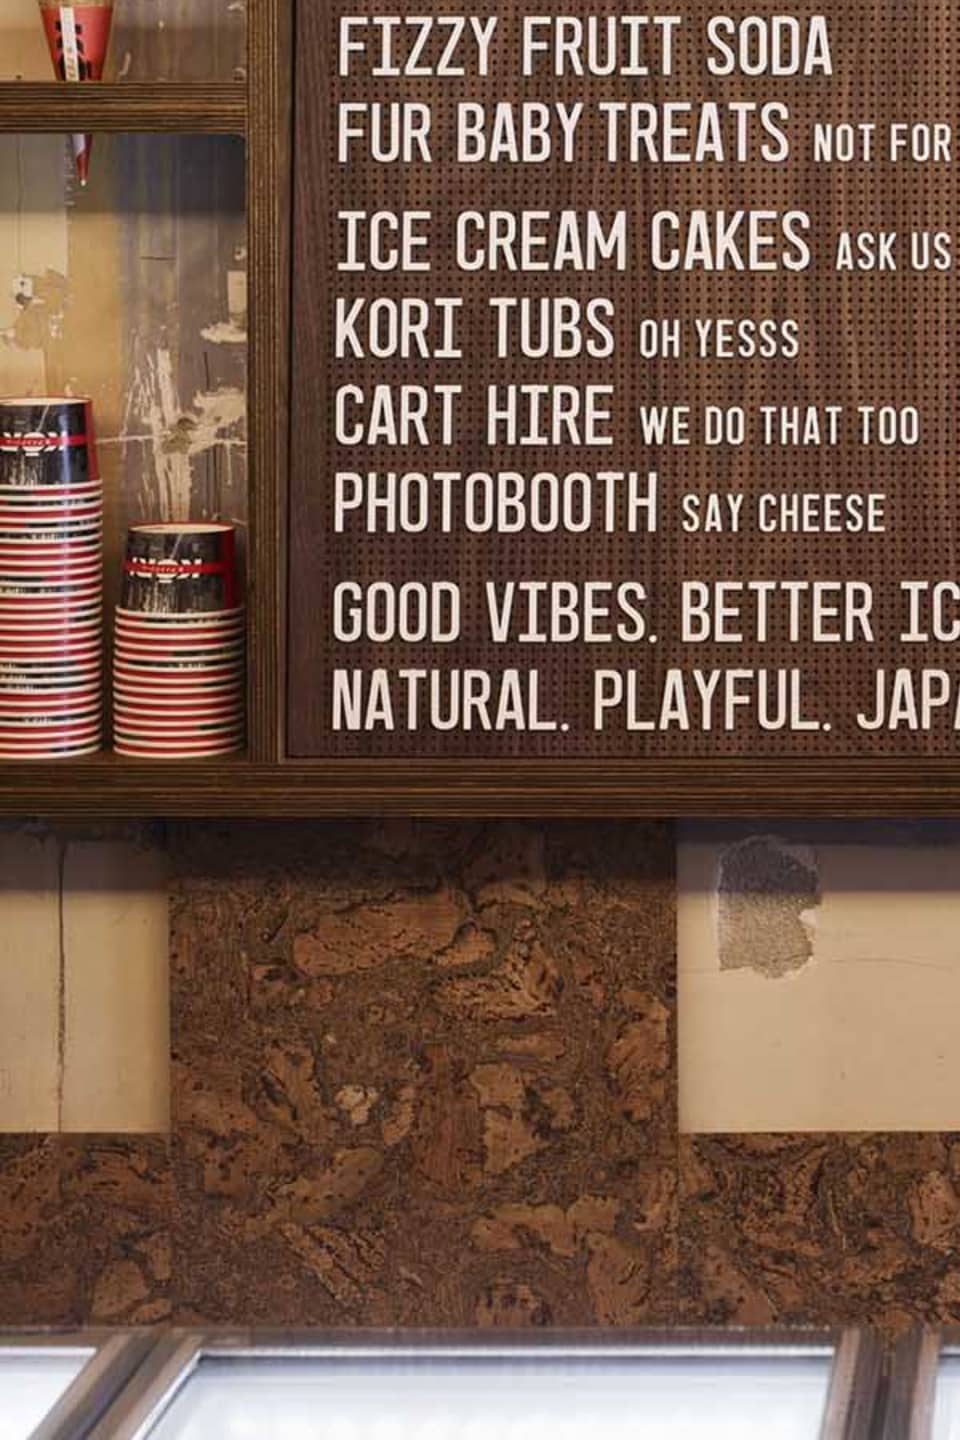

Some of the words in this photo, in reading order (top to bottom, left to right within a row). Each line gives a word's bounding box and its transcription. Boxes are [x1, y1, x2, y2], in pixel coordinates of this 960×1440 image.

[339, 16, 498, 76] FIZZY
[523, 16, 682, 76] FRUIT
[707, 16, 833, 76] SODA
[338, 102, 432, 163] FUR
[457, 102, 584, 163] BABY
[598, 101, 789, 163] TREATS
[814, 123, 876, 162] NOT
[890, 123, 952, 162] FOR
[337, 210, 431, 271] ICE
[456, 210, 626, 271] CREAM
[651, 210, 810, 272] CAKES
[836, 231, 897, 271] ASK
[911, 231, 951, 270] US
[335, 297, 463, 358] KORI
[489, 296, 615, 358] TUBS
[640, 319, 680, 359] OH
[695, 319, 799, 358] YESSS
[335, 383, 462, 445] CART
[487, 384, 614, 445] HIRE
[639, 406, 690, 445] WE
[705, 405, 745, 445] DO
[759, 405, 843, 445] THAT
[857, 405, 919, 445] TOO
[334, 471, 657, 533] PHOTOBOOTH
[682, 493, 744, 532] SAY
[759, 493, 886, 532] CHEESE
[333, 581, 460, 642] GOOD
[486, 581, 657, 643] VIBES.
[682, 580, 874, 642] BETTER
[332, 668, 569, 731] NATURAL.
[594, 668, 832, 731] PLAYFUL.
